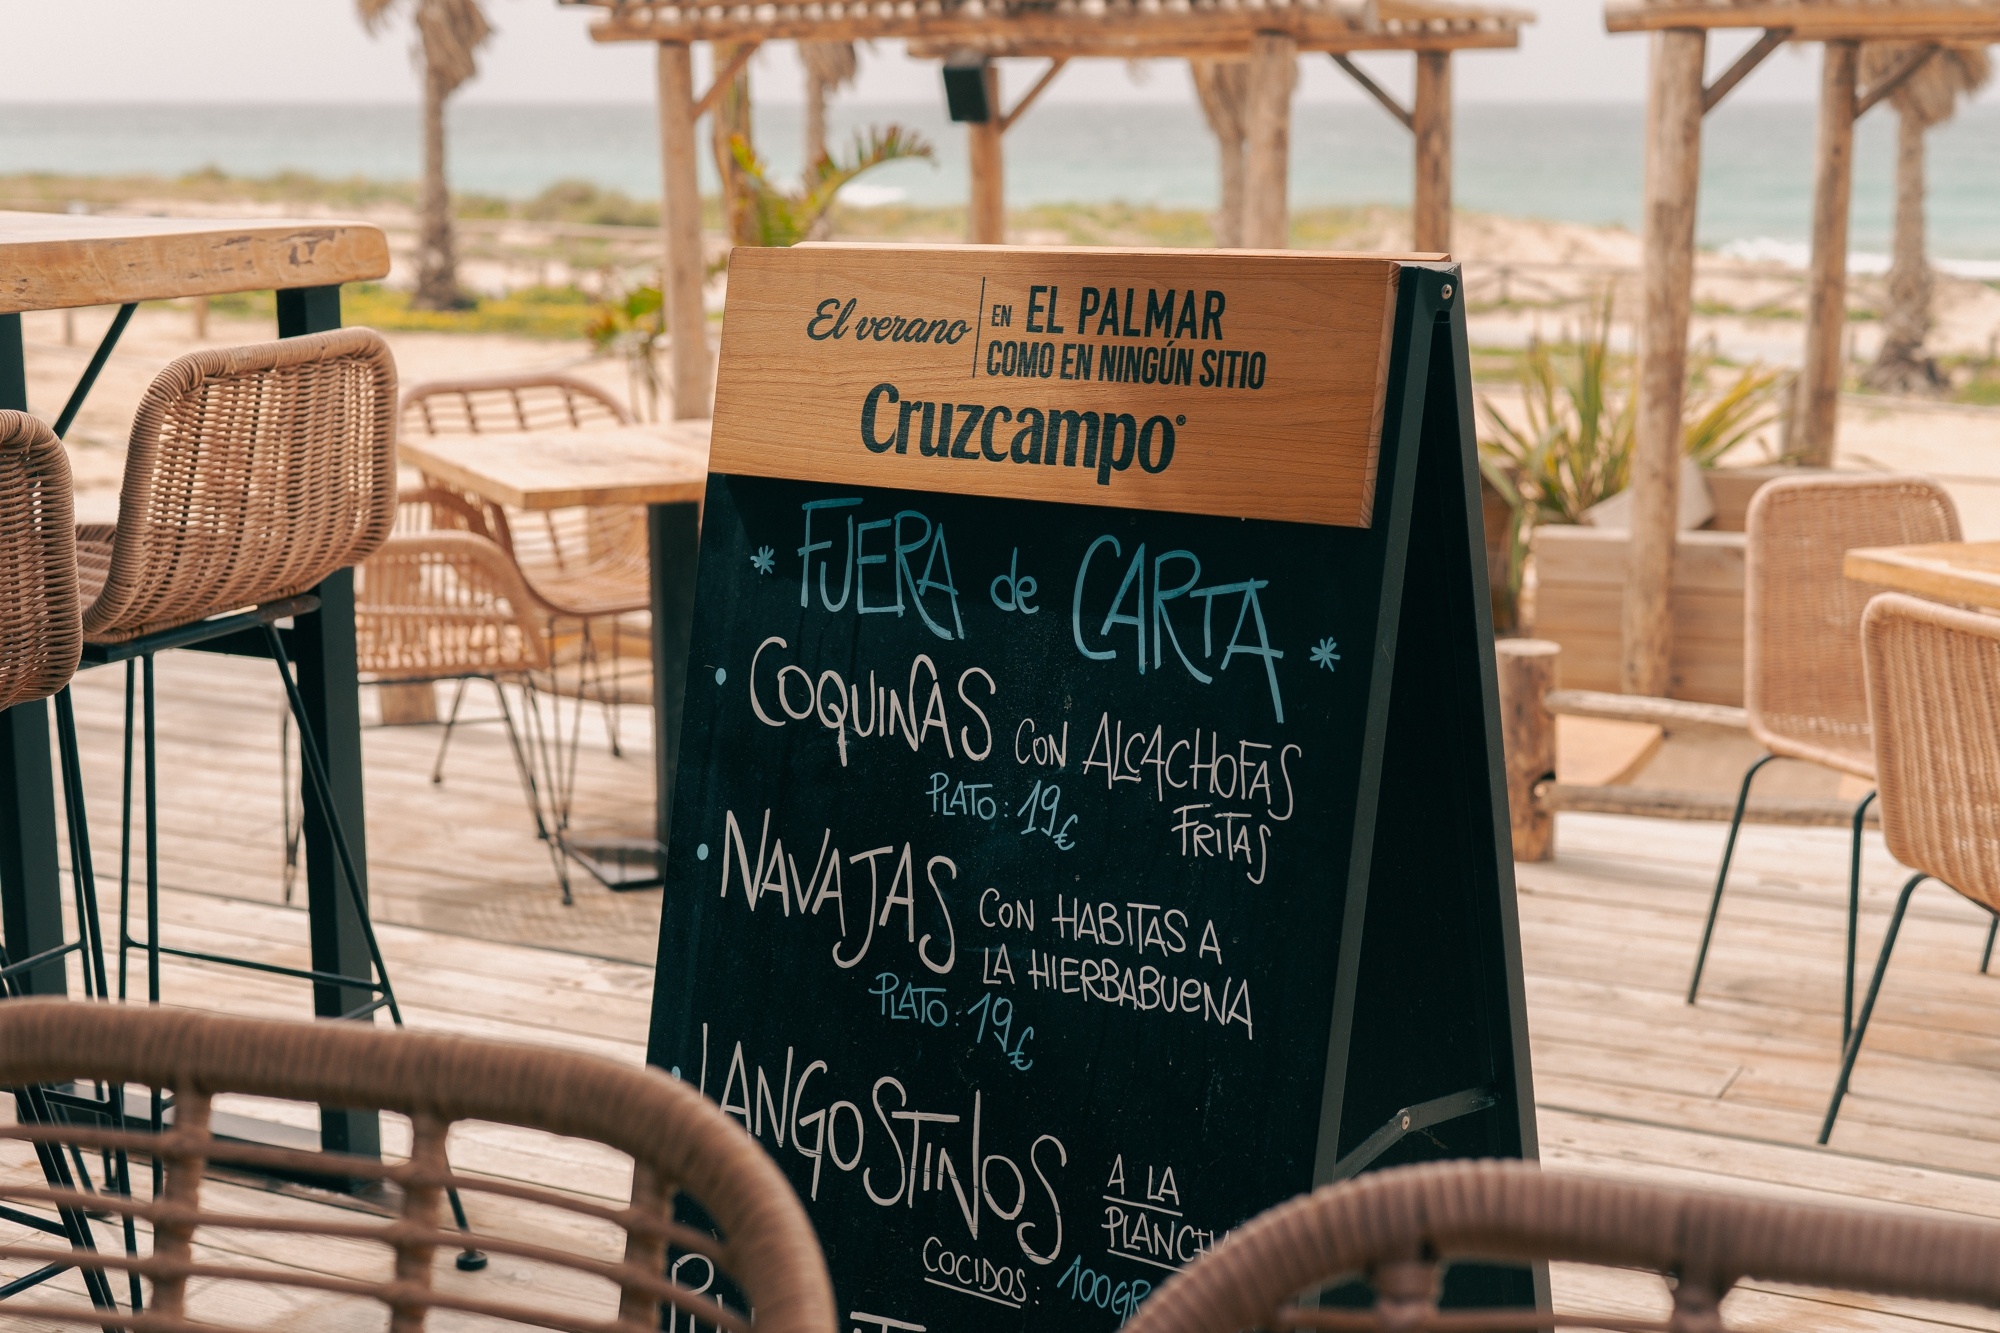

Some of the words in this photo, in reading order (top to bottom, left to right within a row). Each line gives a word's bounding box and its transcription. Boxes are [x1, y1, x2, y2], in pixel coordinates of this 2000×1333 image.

[807, 298, 857, 341] El
[846, 314, 973, 347] verano
[991, 304, 1011, 328] EN
[1026, 285, 1065, 335] EL
[1077, 287, 1227, 341] PALMAR
[986, 341, 1056, 379] COMO
[1060, 344, 1095, 381] EN
[1099, 340, 1193, 387] NINGÚN
[1199, 348, 1267, 390] SITIO
[797, 497, 966, 640] FUERA
[989, 547, 1041, 614] de
[1072, 534, 1284, 723] CARTA
[749, 636, 997, 767] COQUINAS
[1014, 717, 1068, 767] CON
[1082, 711, 1302, 821] ALCACHOFAS
[1170, 803, 1272, 885] FRITAS
[720, 808, 957, 975] NAVAJAS
[978, 886, 1035, 932] CON
[1052, 893, 1188, 954] HABITAS
[1198, 919, 1223, 965] A
[982, 943, 1014, 985] LA
[1107, 1153, 1125, 1196] A
[1146, 1165, 1180, 1206] LA
